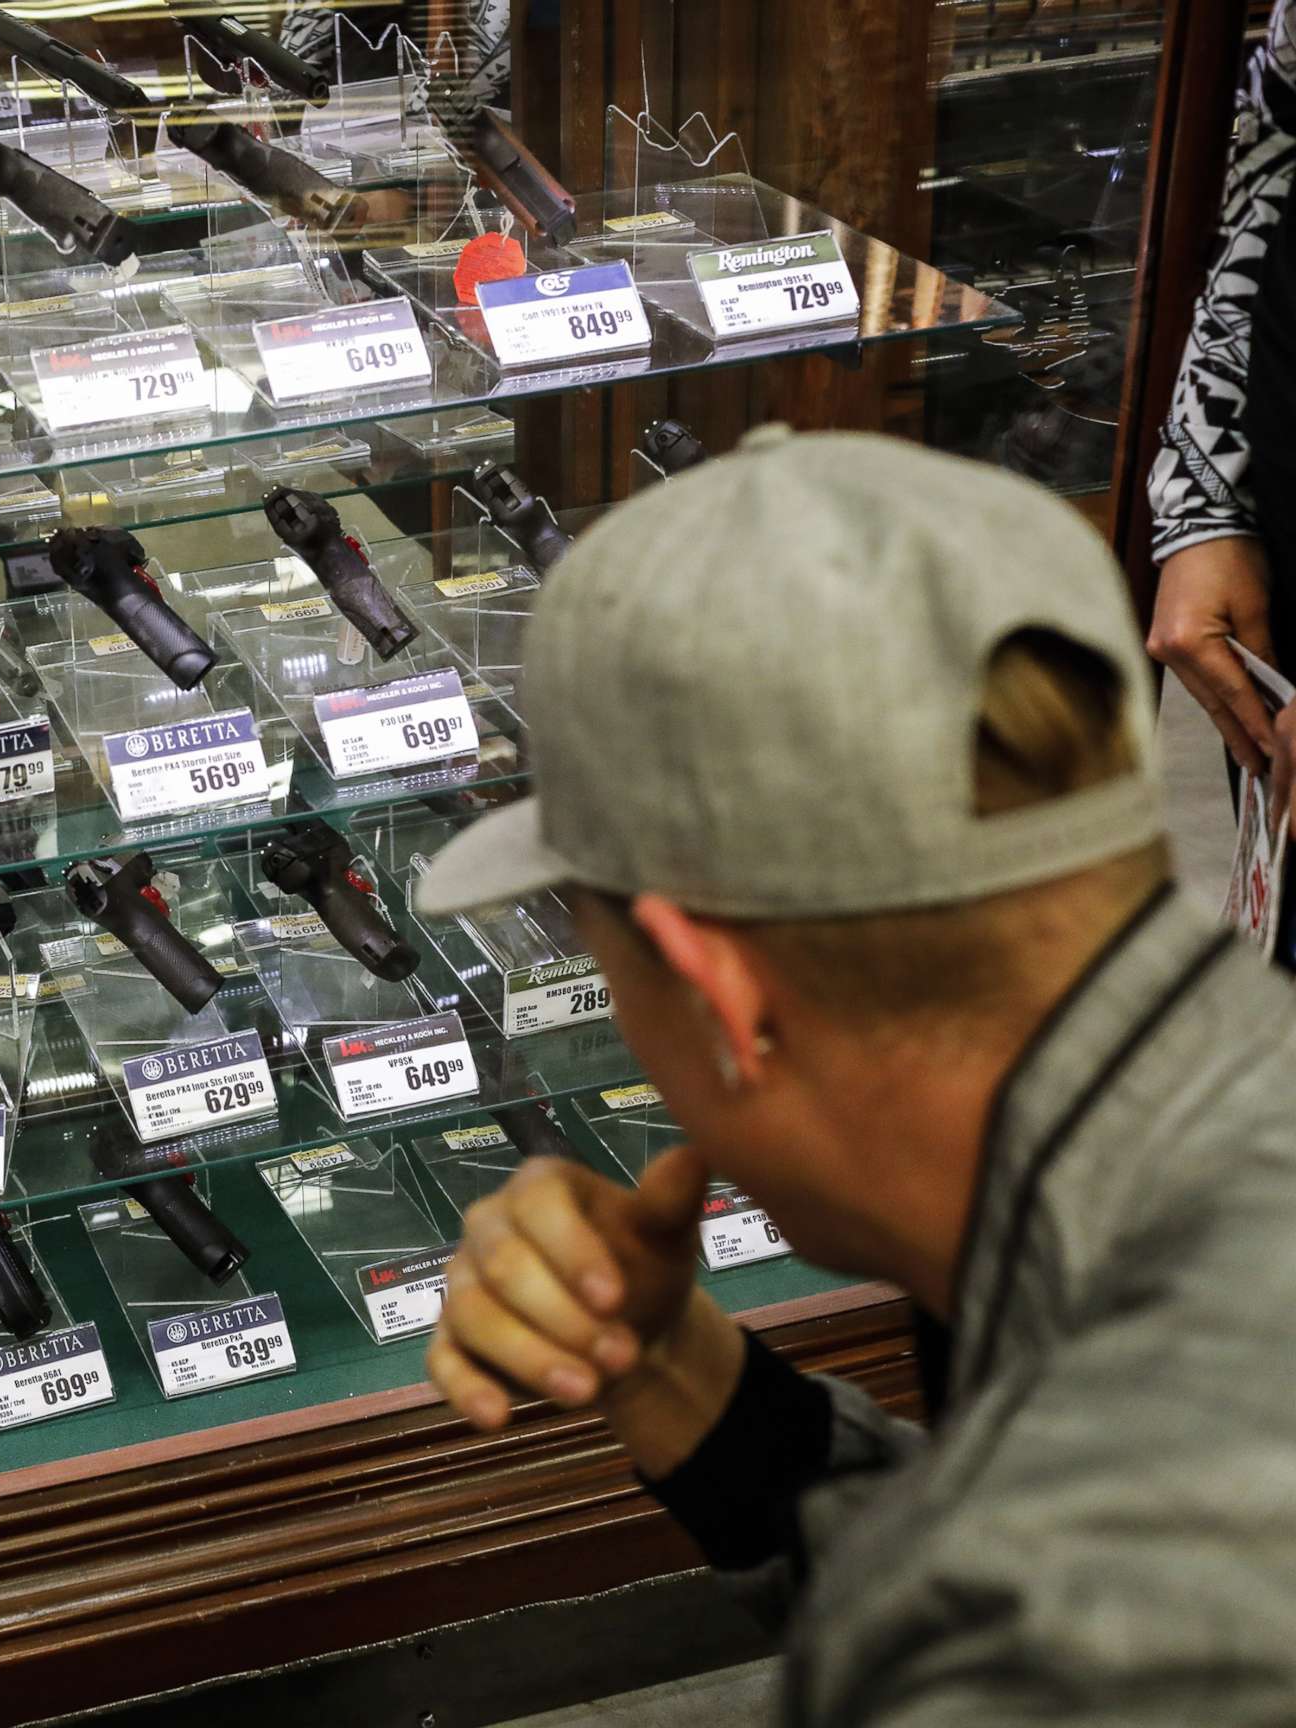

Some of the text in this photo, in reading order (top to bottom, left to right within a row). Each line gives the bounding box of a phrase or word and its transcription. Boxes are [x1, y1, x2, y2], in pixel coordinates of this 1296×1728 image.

[719, 245, 816, 273] Remington
[738, 281, 782, 292] Remington
[571, 304, 592, 313] Mark
[312, 321, 347, 332] HECKLER
[91, 349, 127, 362] HECKLER
[151, 722, 240, 751] BERETTA
[132, 765, 162, 778] Beretta
[182, 756, 207, 768] Storm
[208, 755, 222, 763] Full
[224, 751, 242, 760] Size
[546, 982, 593, 999] RM380 Micro
[375, 1037, 405, 1047] HECKLER
[415, 1031, 433, 1041] KOCH
[435, 1027, 448, 1036] INC.
[165, 1042, 247, 1074] BERETTA
[388, 1055, 414, 1069] VP9SK
[146, 1070, 255, 1102] Beretta PX4 Inox Sts Full Size
[742, 1216, 752, 1225] HK
[403, 1262, 431, 1273] HECKLER
[405, 1285, 425, 1294] HK45
[189, 1306, 268, 1336] BERETTA
[201, 1333, 243, 1350] Beretta Px4
[4, 1335, 84, 1367] BERETTA
[14, 1368, 62, 1388] Beretta 96A1
